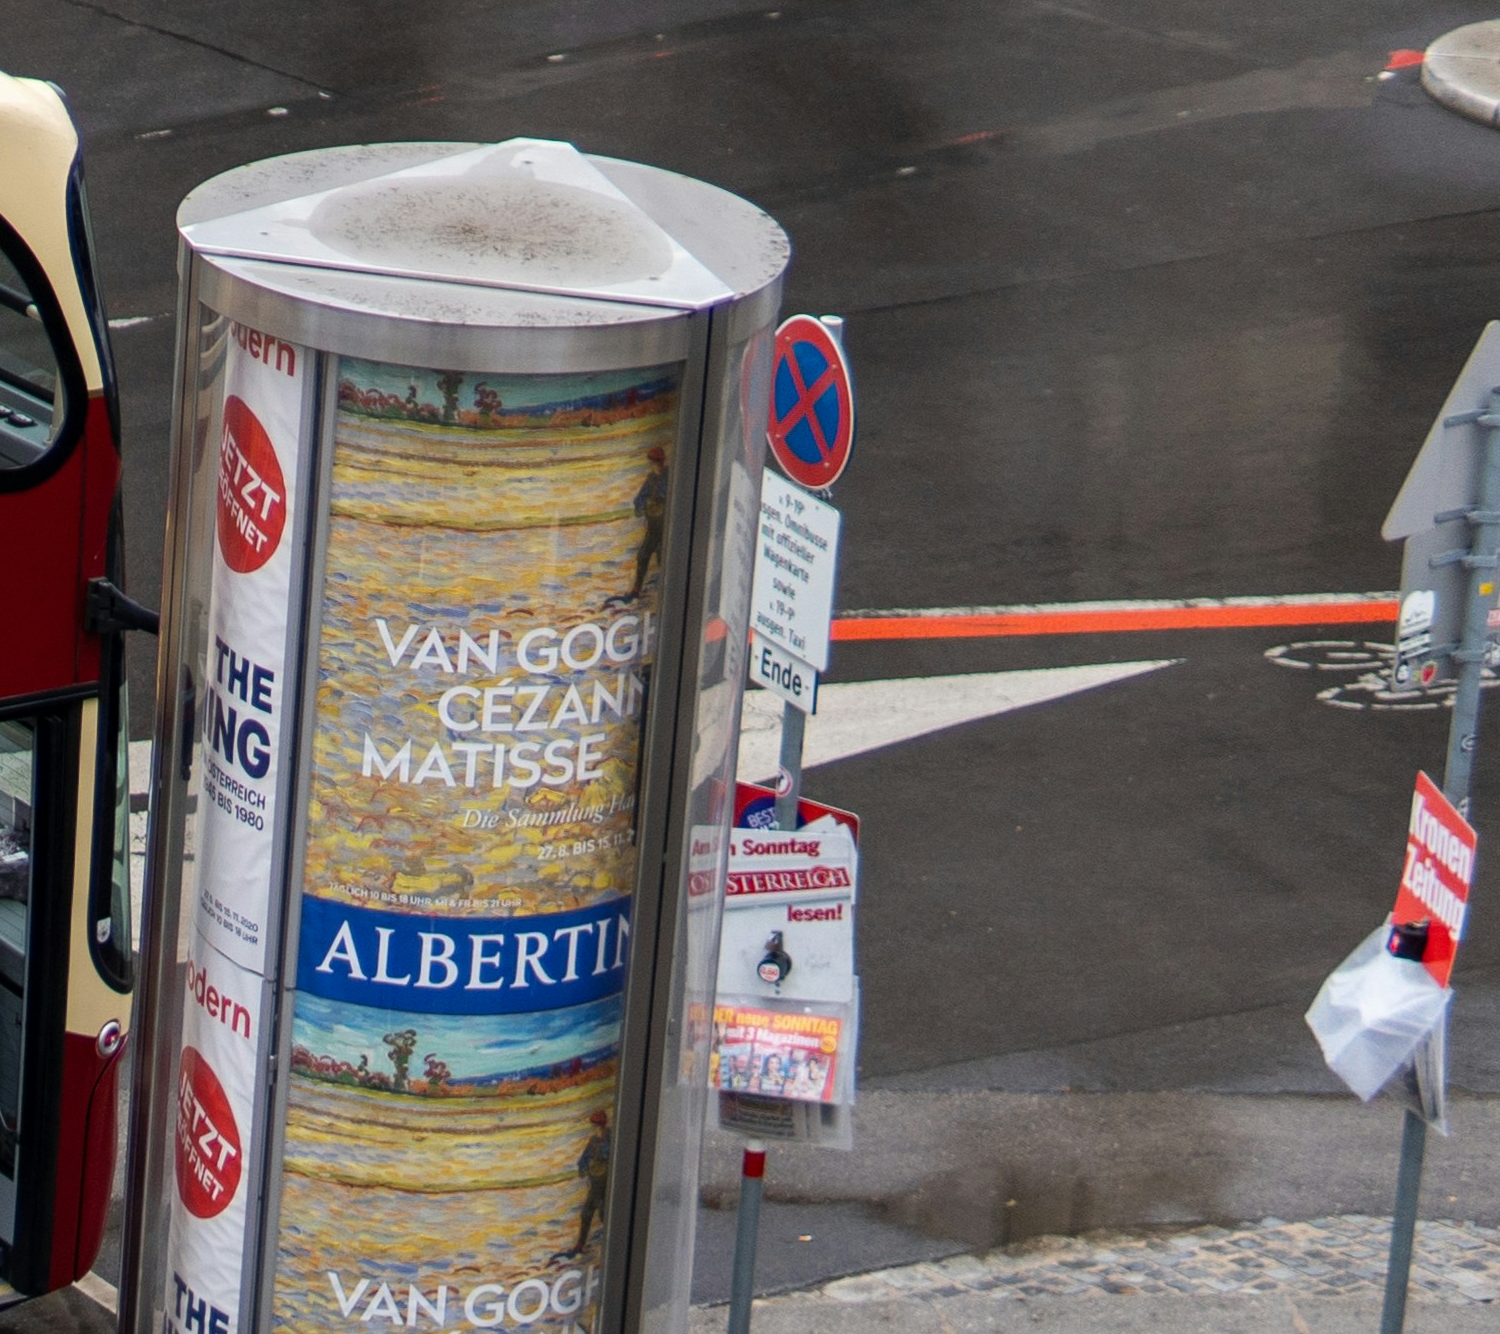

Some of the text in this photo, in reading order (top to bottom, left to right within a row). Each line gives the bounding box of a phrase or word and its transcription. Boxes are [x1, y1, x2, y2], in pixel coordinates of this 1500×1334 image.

[221, 423, 280, 522] JETZT
[375, 618, 500, 675] VAN
[788, 627, 806, 652] Taxi
[215, 634, 275, 715] THE
[760, 643, 803, 696] Ende
[437, 670, 644, 733] CÉZANN
[361, 731, 606, 788] MATISSE
[217, 792, 265, 831] BIS 1980
[462, 808, 500, 829] Die
[505, 800, 604, 828] Sammlung
[1408, 789, 1471, 885] Kronen
[573, 838, 596, 856] BIS
[742, 837, 821, 857] Sonntag
[369, 890, 379, 900] 10
[380, 892, 397, 903] BIS
[500, 897, 522, 908] UHR
[787, 903, 843, 922] lesen!
[1402, 841, 1467, 943] Zeitung
[315, 912, 631, 990] ALBERTIN
[187, 958, 252, 1040] odern
[773, 1014, 838, 1036] SONNTAG
[745, 1026, 753, 1040] 3
[180, 1070, 237, 1172] JETZT
[327, 1270, 448, 1328] VAN
